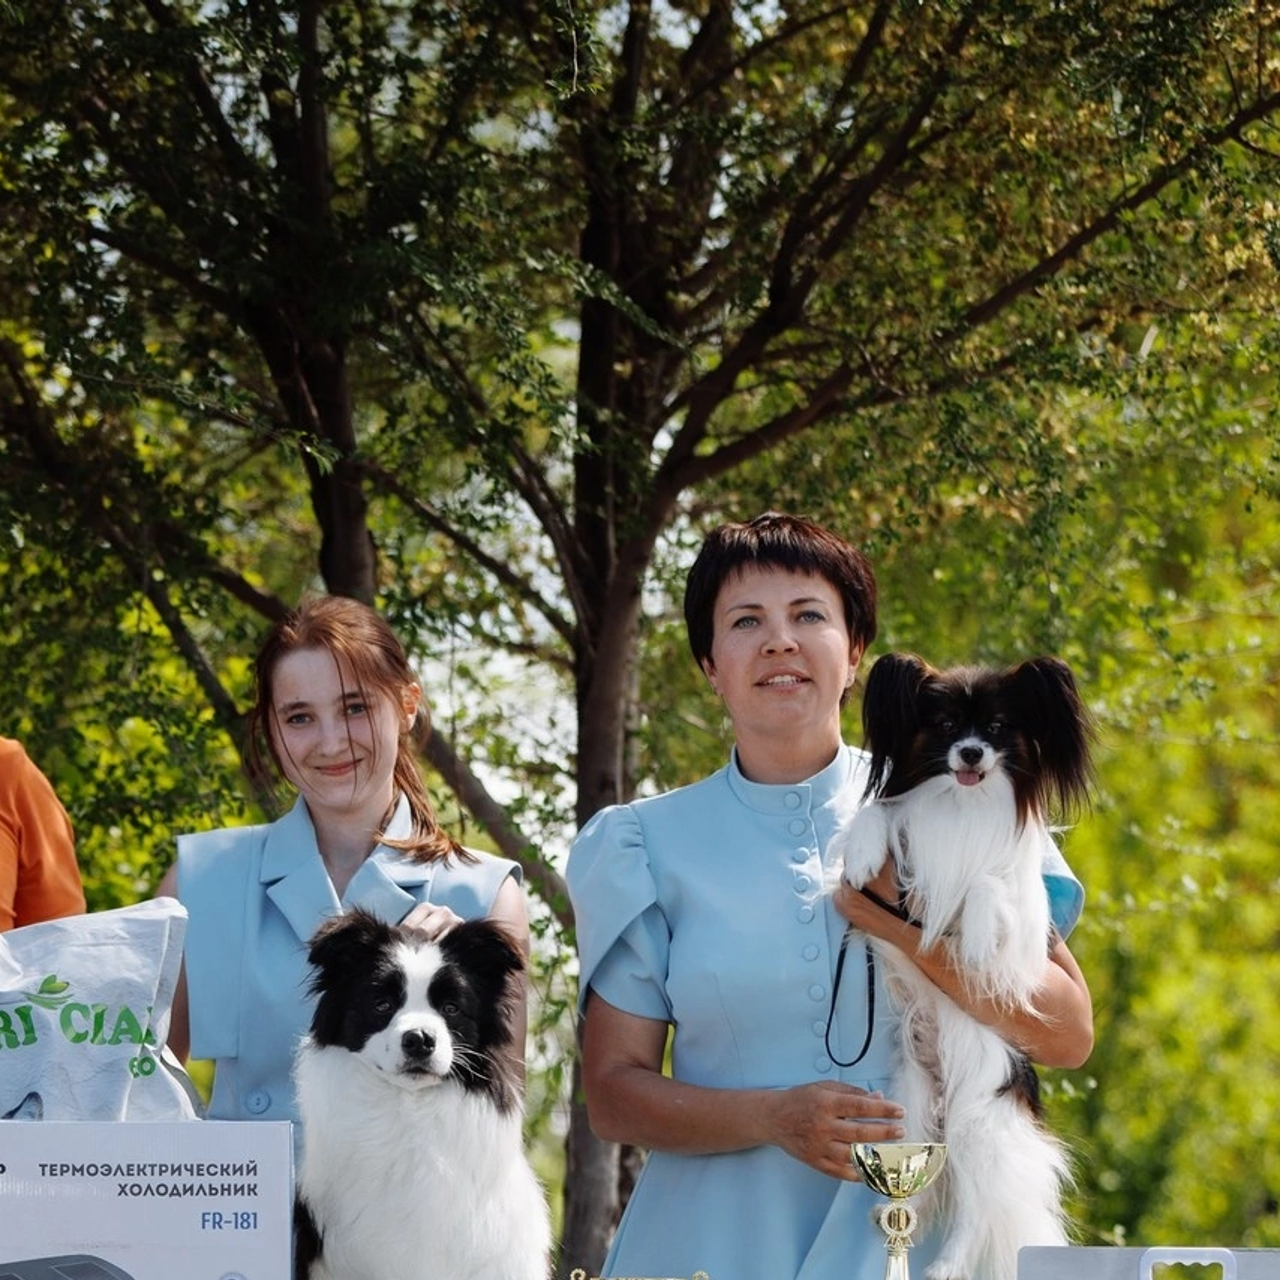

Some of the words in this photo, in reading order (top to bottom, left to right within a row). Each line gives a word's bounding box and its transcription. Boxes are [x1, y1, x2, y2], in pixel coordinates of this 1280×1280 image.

[39, 1160, 258, 1177] ТЕРМОЭЛЕКТРИЧЕСКИЙ
[118, 1183, 258, 1198] ХОЛОДИЛЬНИК
[201, 1212, 258, 1230] FR-181
